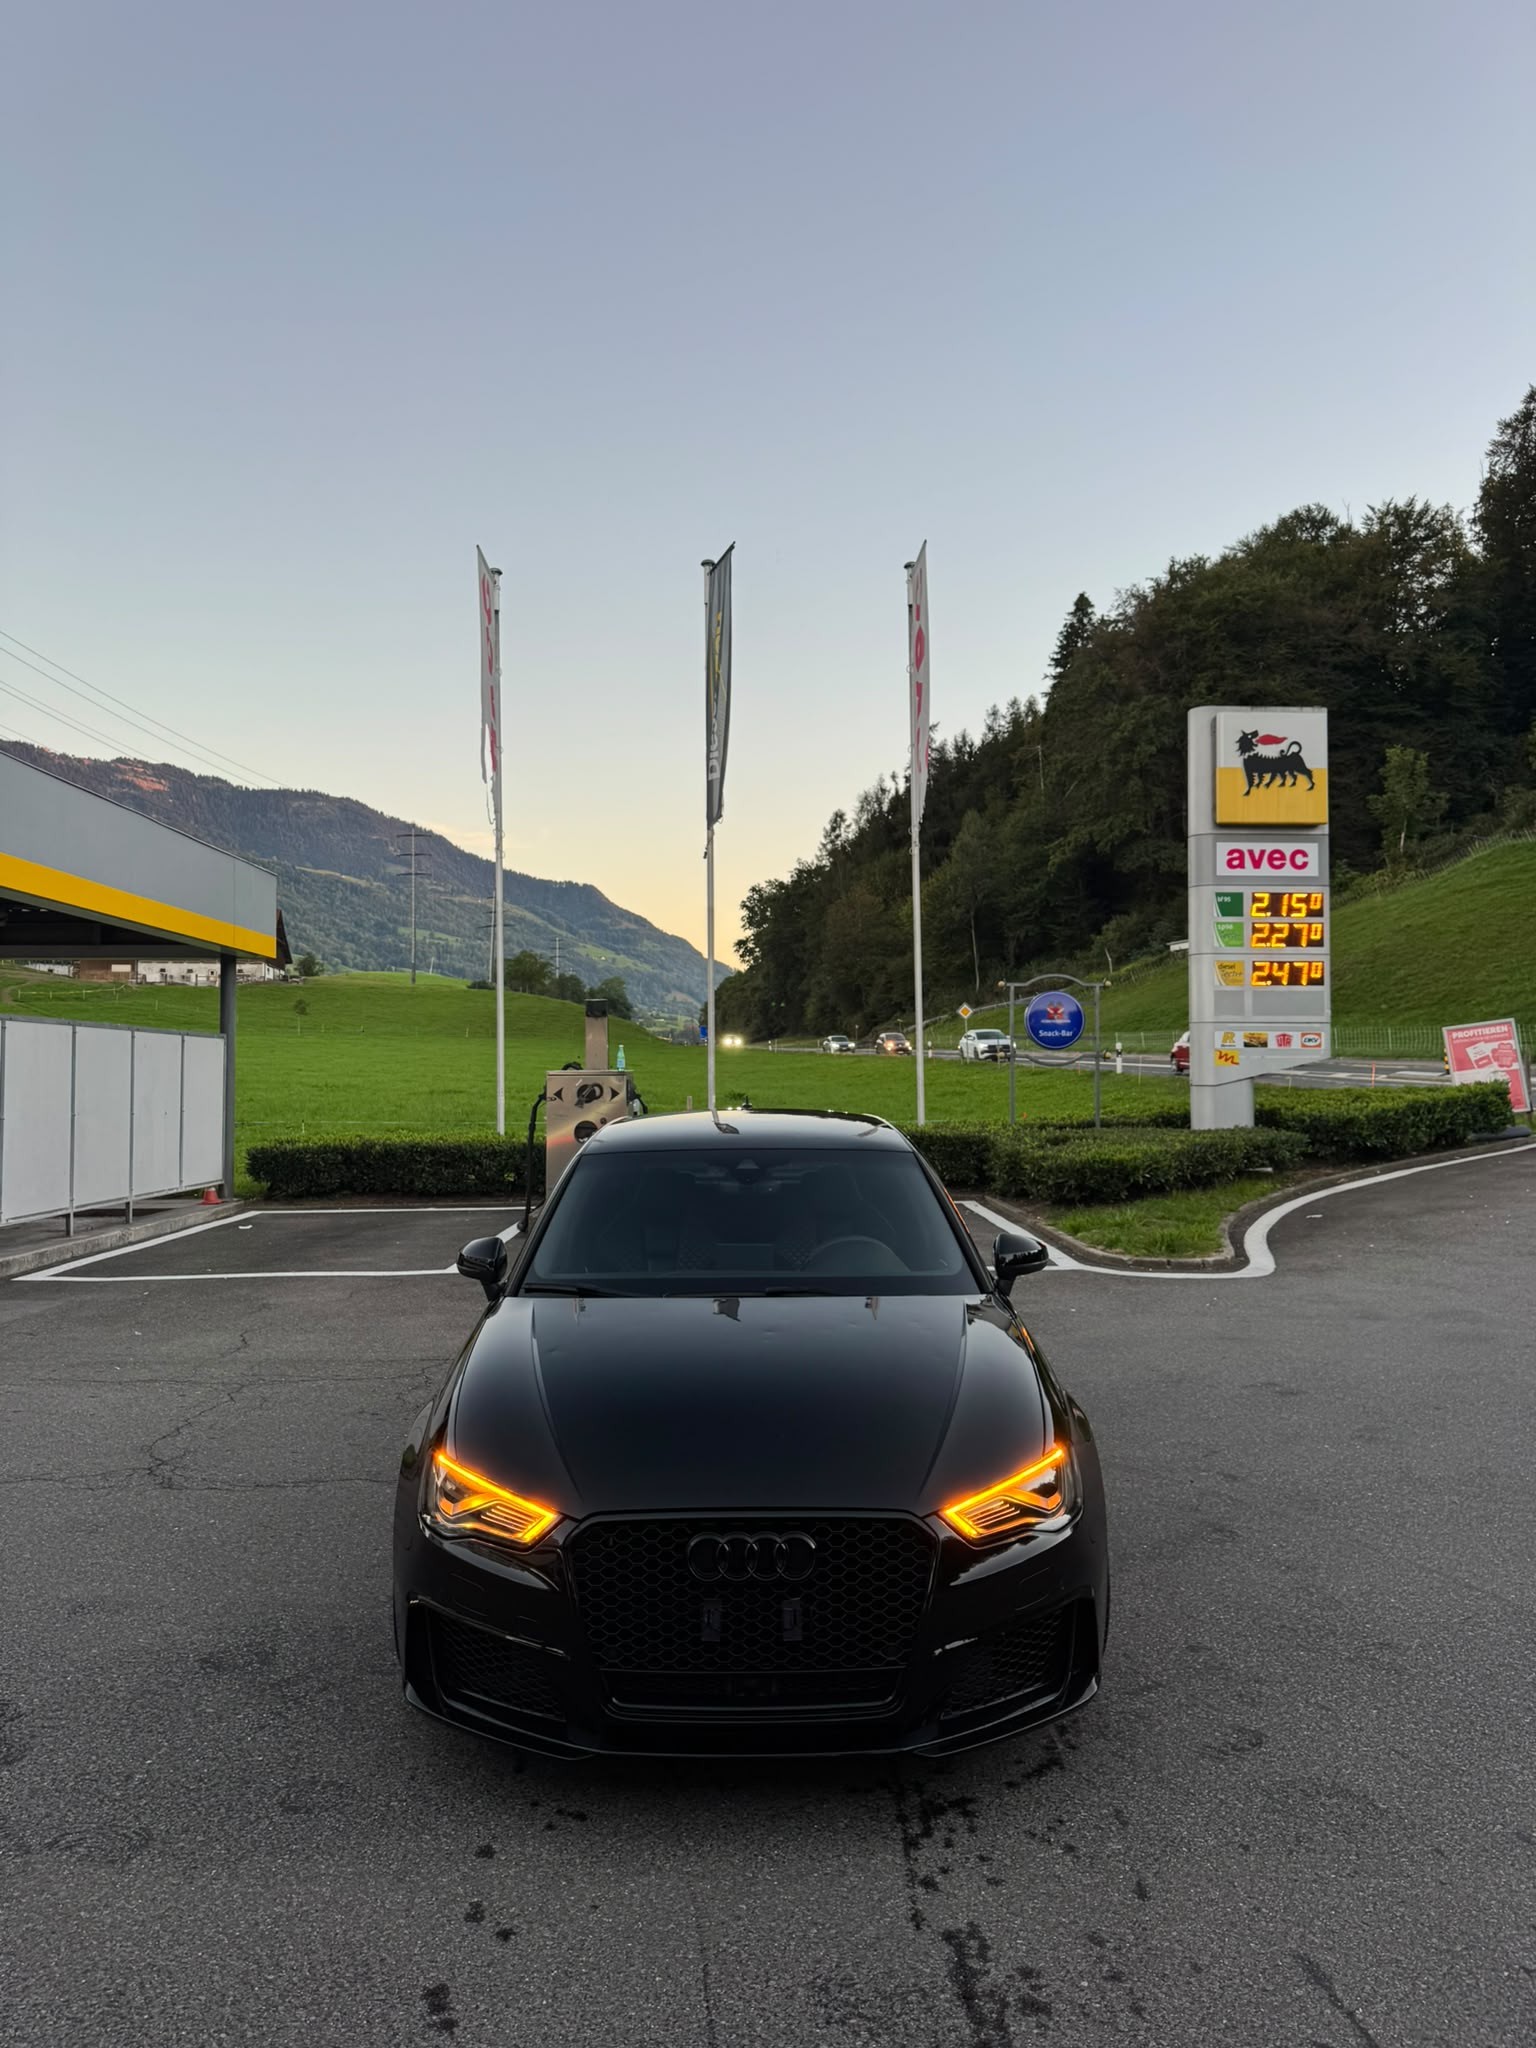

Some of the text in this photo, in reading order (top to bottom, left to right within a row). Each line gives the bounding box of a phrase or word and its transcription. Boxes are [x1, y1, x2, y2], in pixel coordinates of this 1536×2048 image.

[1226, 848, 1309, 871] avec
[1039, 1029, 1073, 1037] Snack-Bar
[1452, 1025, 1508, 1039] PROFITIEREN
